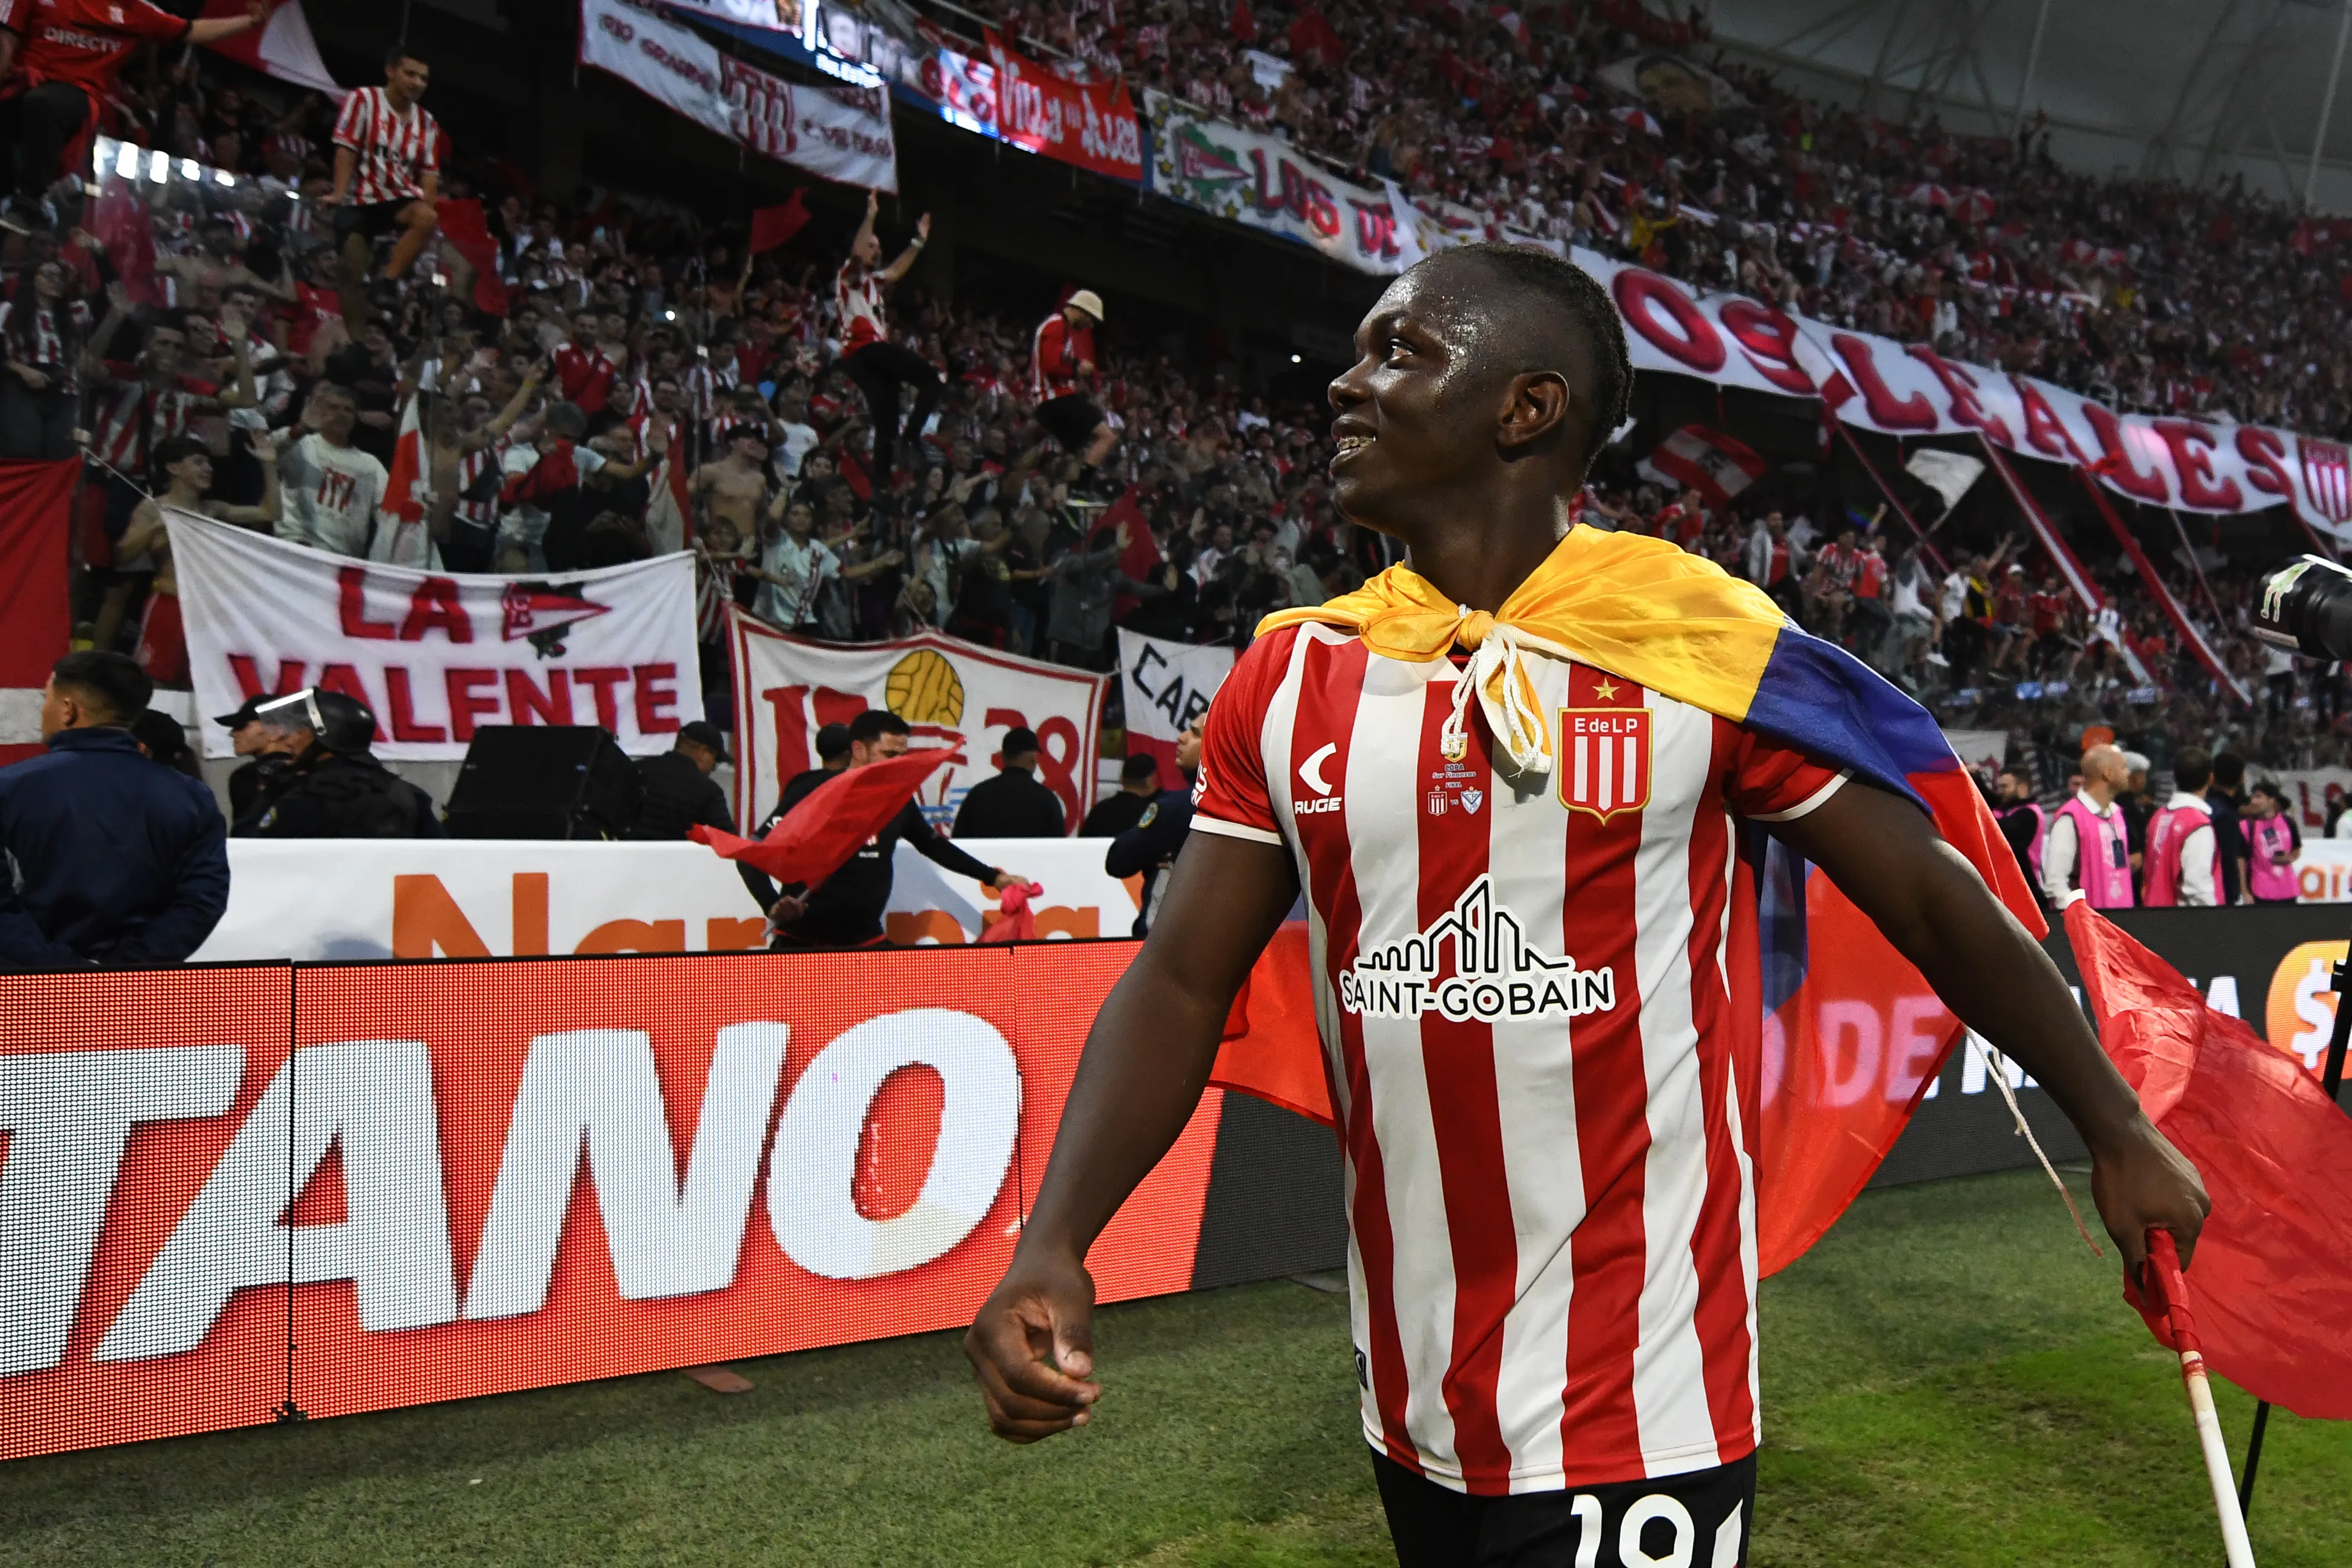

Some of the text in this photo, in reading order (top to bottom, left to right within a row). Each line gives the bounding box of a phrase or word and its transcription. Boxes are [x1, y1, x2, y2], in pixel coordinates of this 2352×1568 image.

[1249, 148, 1341, 239] LOS
[1612, 269, 2289, 511] OS LEALES
[338, 566, 473, 644] LA
[1295, 797, 1342, 814] RUGE
[1342, 973, 1610, 1016] SAINT-GOBAIN
[0, 1007, 1022, 1379] TANO
